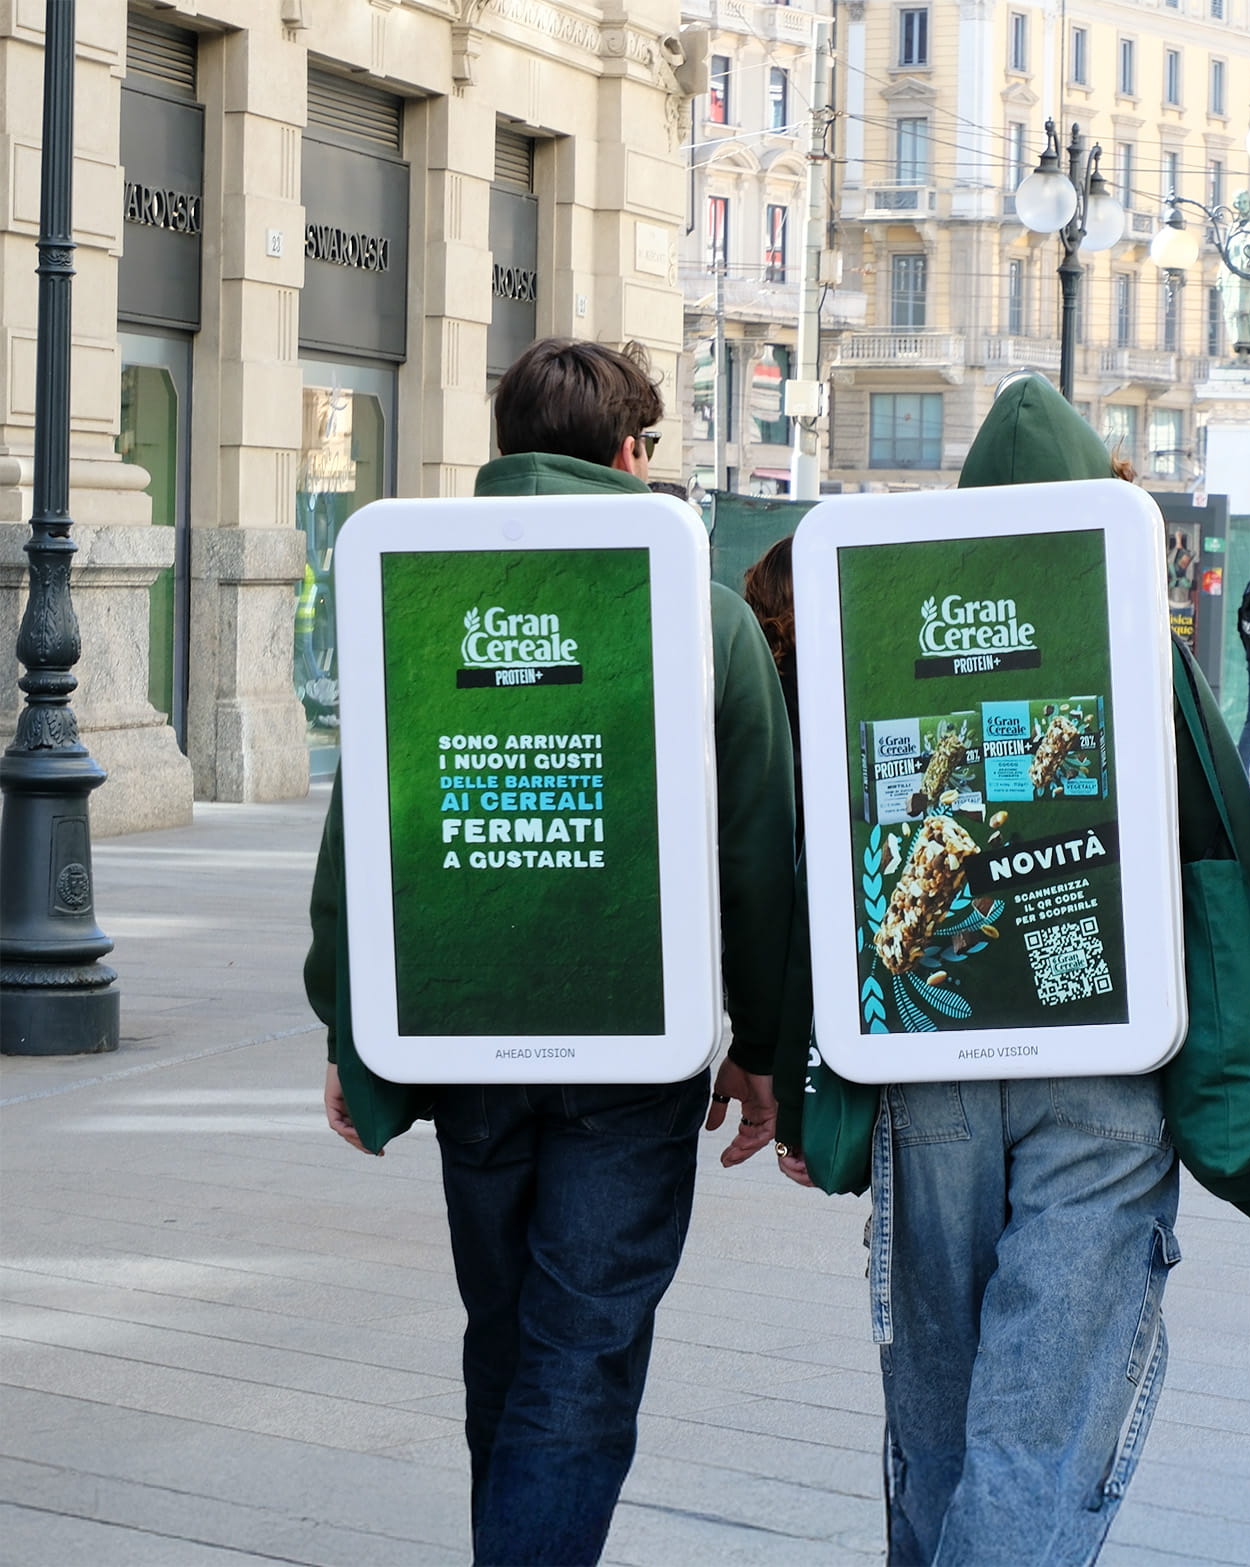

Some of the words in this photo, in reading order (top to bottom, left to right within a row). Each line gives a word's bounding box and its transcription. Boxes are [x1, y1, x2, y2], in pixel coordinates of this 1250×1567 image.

[306, 223, 391, 271] SWAROVSKI
[941, 595, 1016, 625] Gran
[484, 606, 559, 636] Gran
[924, 618, 1036, 651] Cereale
[467, 632, 578, 661] Cereale
[953, 655, 1001, 675] PROTEIN+
[495, 668, 544, 686] PROTEIN+
[989, 724, 1026, 735] Cereale
[994, 716, 1019, 725] Gran
[439, 735, 498, 750] SONO
[505, 734, 601, 749] ARRIVATI
[880, 743, 916, 755] Cereale
[885, 736, 910, 745] Gran
[983, 740, 1033, 757] PROTEIN+
[439, 754, 446, 769] I
[454, 754, 526, 769] NUOVI
[534, 753, 602, 769] GUSTI
[874, 758, 922, 780] PROTEIN+
[440, 776, 499, 789] DELLE
[505, 775, 604, 788] BARRETTE
[440, 792, 469, 811] AI
[480, 791, 604, 811] CEREALI
[442, 818, 604, 843] FERMATI
[443, 851, 460, 869] A
[469, 850, 605, 868] GUSTARLE
[989, 830, 1106, 881] NOVITÀ
[1014, 878, 1090, 903] SCANNERIZZA
[1024, 902, 1036, 912] IL
[1037, 897, 1053, 910] QR
[1055, 891, 1085, 906] CODE
[1015, 913, 1036, 926] PER
[1038, 899, 1098, 919] SCOPRIRLE
[496, 1048, 532, 1059] AHEAD
[534, 1048, 576, 1058] VISION
[958, 1047, 995, 1060] AHEAD
[996, 1046, 1039, 1058] VISION
